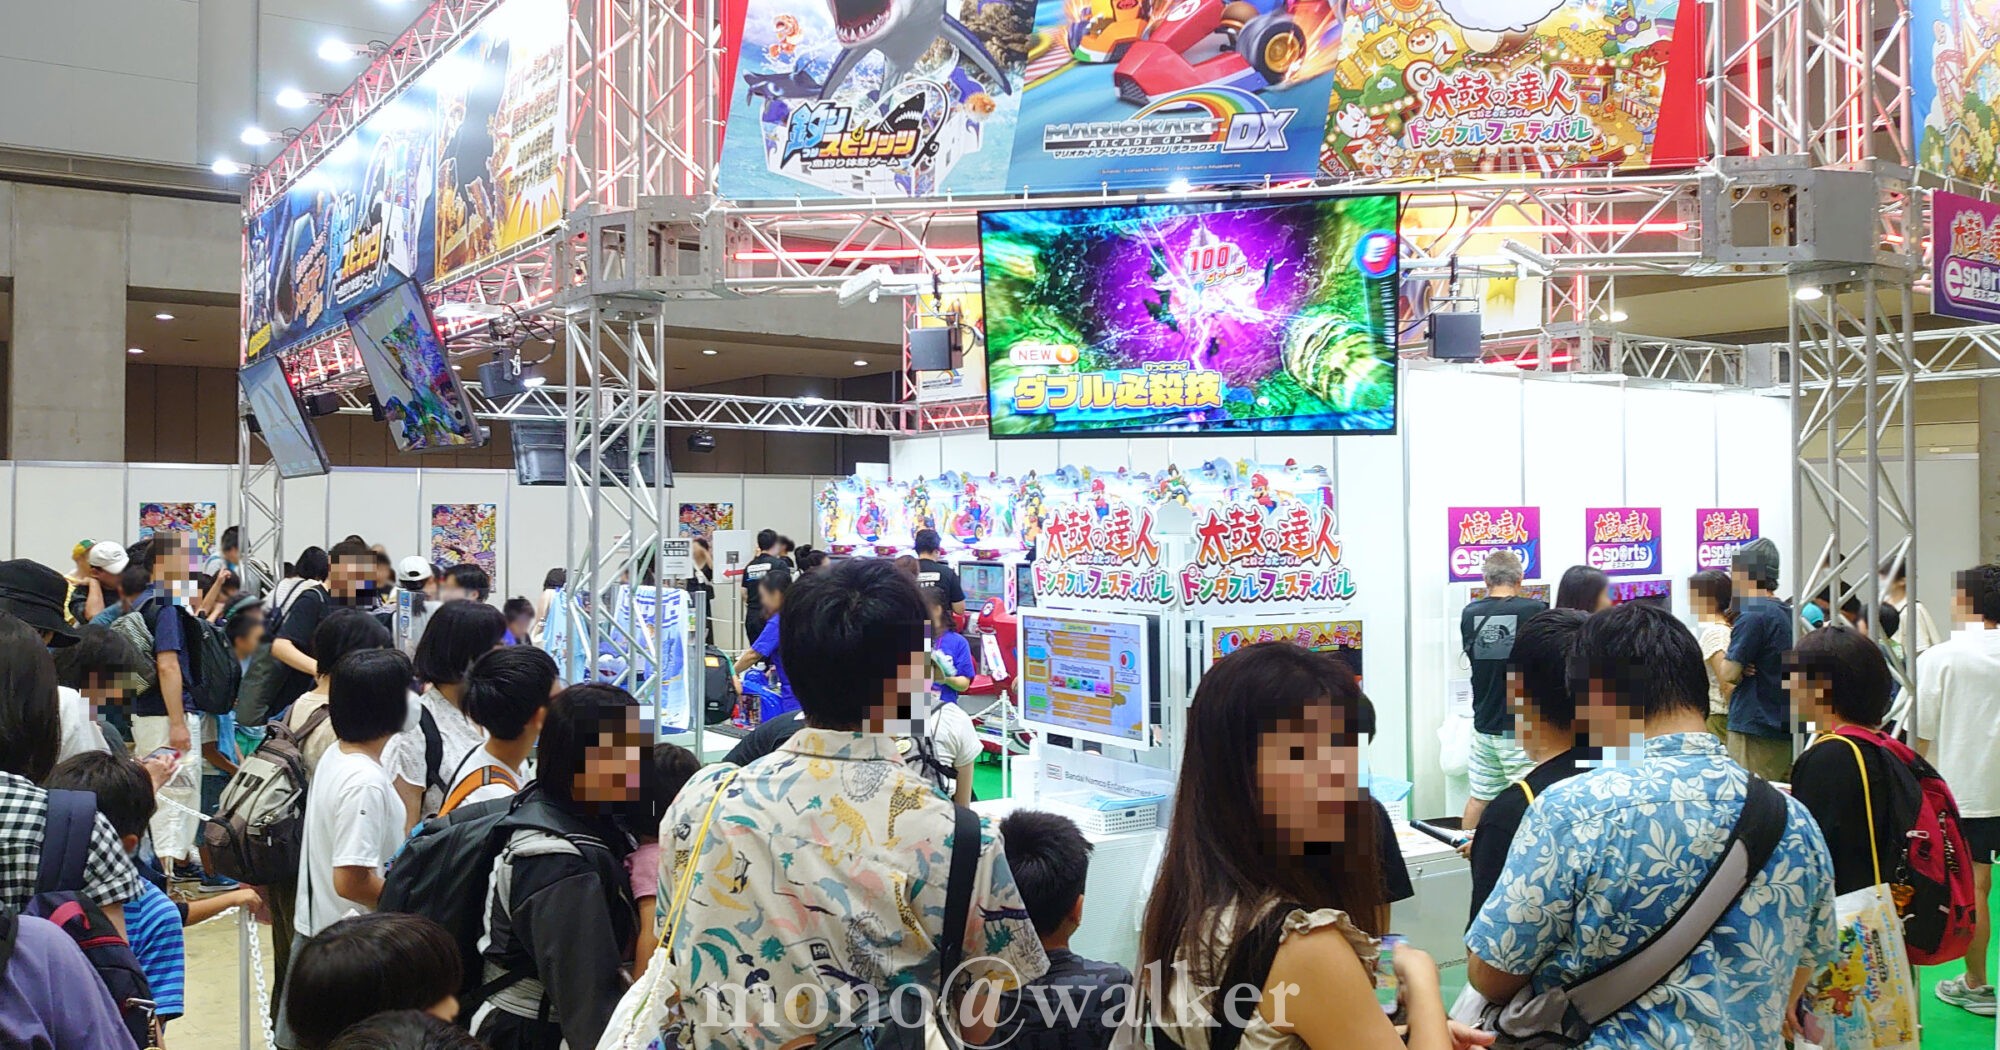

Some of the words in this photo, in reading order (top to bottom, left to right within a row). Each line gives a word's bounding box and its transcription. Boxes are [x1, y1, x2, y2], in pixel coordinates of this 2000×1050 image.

[1425, 68, 1580, 120] 太鼓の達人
[1224, 111, 1296, 150] DX
[1190, 246, 1230, 272] 100
[1018, 349, 1052, 361] NEW
[1014, 371, 1221, 410] ダブル必殺技
[1047, 507, 1161, 560] 太鼓の達人
[1199, 502, 1342, 566] 太鼓の達人
[1459, 510, 1528, 544] 太鼓の達人
[1594, 511, 1652, 542] 太鼓の達人
[1703, 511, 1751, 541] 太鼓の達人
[1588, 544, 1648, 569] esports
